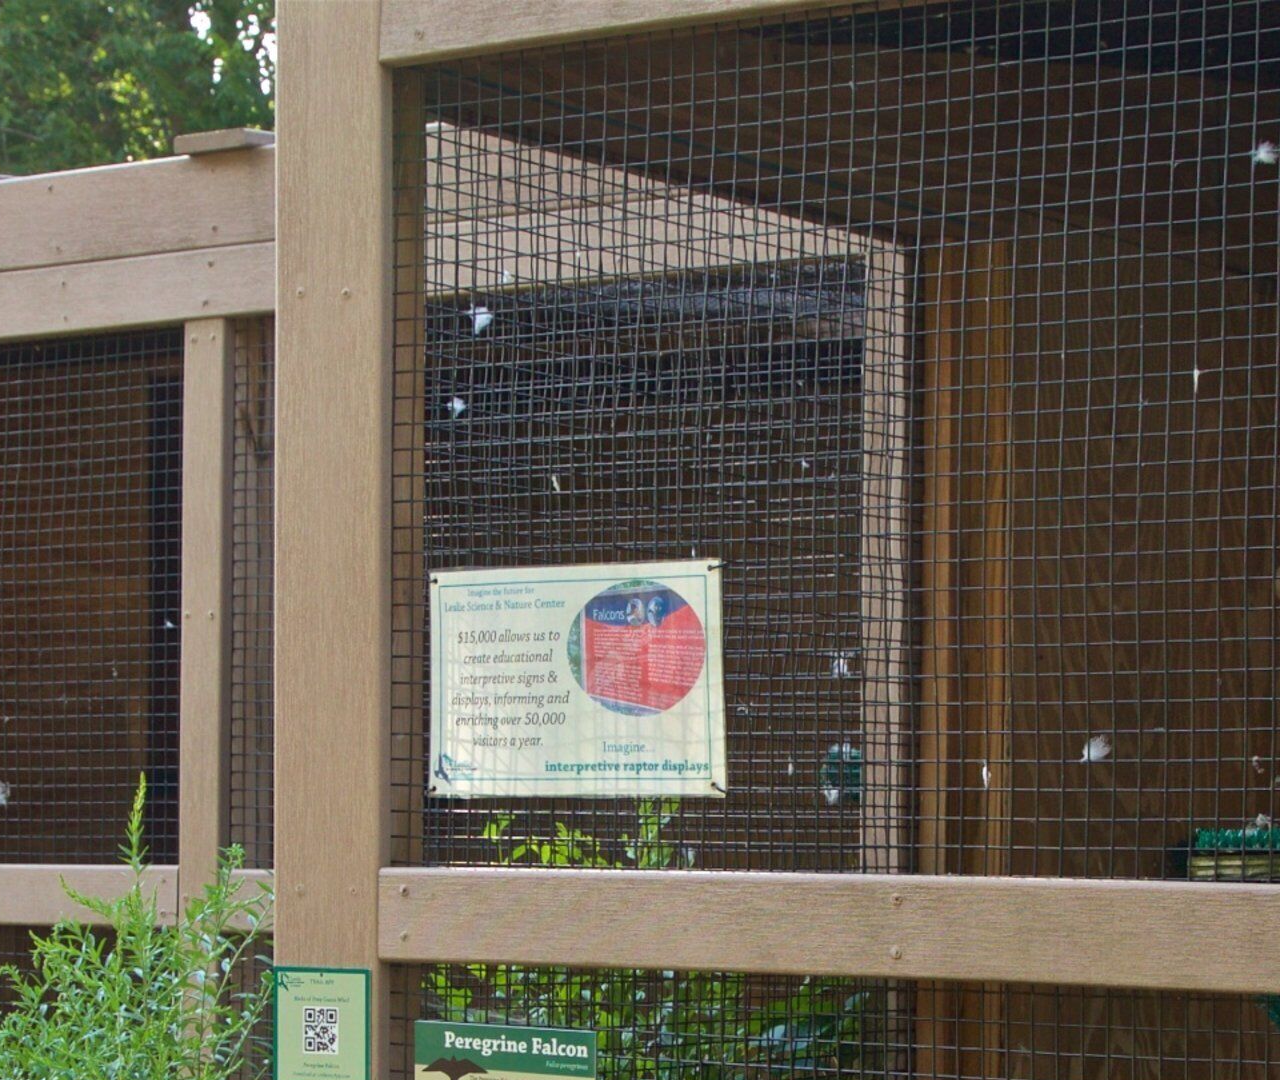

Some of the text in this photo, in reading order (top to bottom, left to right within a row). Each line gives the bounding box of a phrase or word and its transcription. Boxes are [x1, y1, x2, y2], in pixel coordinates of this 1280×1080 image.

[467, 588, 491, 597] Imagine
[504, 586, 522, 595] future
[524, 586, 534, 594] for
[467, 601, 493, 611] Science
[495, 601, 502, 610] &
[504, 600, 532, 610] Nature
[534, 599, 565, 608] Center
[592, 609, 625, 621] Falcons
[458, 629, 560, 644] $15,000 allows us to
[463, 649, 553, 665] create educational
[460, 670, 558, 687] interpretive signs &
[452, 690, 570, 709] displays, informing and
[456, 711, 566, 730] enriching over 50,000
[473, 735, 544, 750] visitors a year.
[545, 760, 709, 775] interpretive raptor displays
[444, 1031, 588, 1058] Peregrine Falcon
